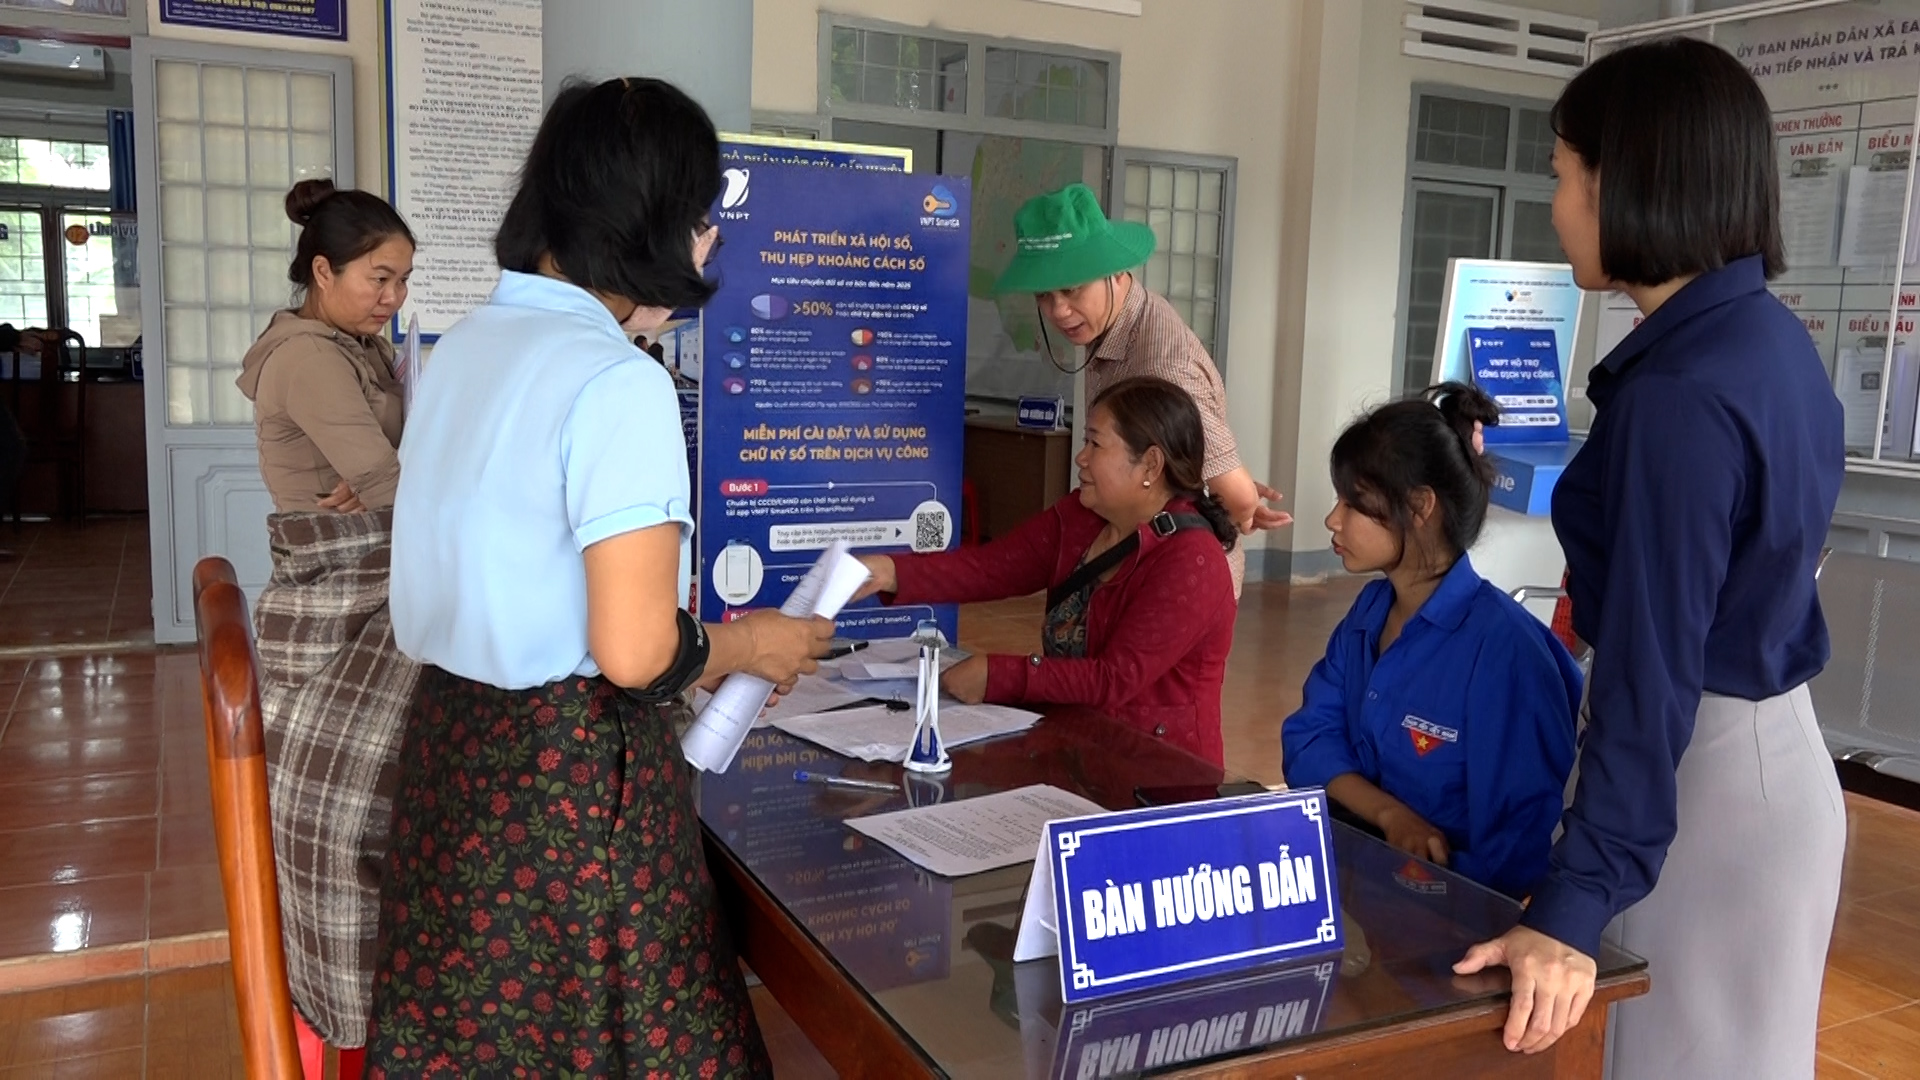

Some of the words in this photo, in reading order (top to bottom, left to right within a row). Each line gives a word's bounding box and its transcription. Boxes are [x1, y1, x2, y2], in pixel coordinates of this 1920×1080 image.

[1737, 43, 1754, 58] ỦY
[1758, 41, 1786, 56] BAN
[1790, 32, 1832, 50] NHÂN
[1836, 26, 1869, 44] DÂN
[1873, 20, 1896, 39] XÃ
[1776, 55, 1803, 74] TIẾP
[1806, 51, 1848, 71] NHẬN
[1854, 46, 1874, 63] VÀ
[1880, 40, 1908, 60] TRẢ
[1775, 119, 1800, 132] KHEN
[1803, 112, 1842, 130] THƯỞNG
[1790, 141, 1814, 156] VĂN
[1818, 137, 1843, 154] BẢN
[1868, 129, 1900, 150] BIỂU
[719, 211, 750, 220] VNPT
[920, 217, 935, 226] VNPT
[774, 229, 809, 244] PHÁT
[811, 230, 847, 247] TRIỂN
[850, 233, 867, 248] XÃ
[869, 233, 891, 251] HỘI
[893, 234, 913, 251] SỐ,
[760, 251, 786, 264] THU
[789, 253, 814, 268] HẸP
[817, 252, 870, 269] KHOẢNG
[873, 255, 906, 270] CÁCH
[909, 255, 926, 271] SỐ
[793, 301, 834, 316] >50%
[1848, 314, 1879, 333] BIỂU
[1510, 357, 1522, 368] HỖ
[1523, 359, 1540, 368] TRỢ
[1500, 370, 1520, 379] DỊCH
[1520, 371, 1531, 380] VỤ
[1532, 369, 1555, 378] CÔNG
[744, 423, 776, 440] MIỄN
[779, 425, 801, 440] PHÍ
[803, 424, 825, 440] CÀI
[827, 425, 852, 442] ĐẶT
[854, 424, 871, 439] VÀ
[873, 423, 890, 439] SỬ
[892, 427, 926, 441] DỤNG
[739, 446, 768, 462] CHỮ
[770, 445, 787, 461] KÝ
[789, 444, 807, 461] SỐ
[809, 445, 841, 461] TRÊN
[843, 447, 873, 462] DỊCH
[876, 447, 892, 462] VỤ
[895, 444, 929, 460] CÔNG
[729, 483, 752, 492] Bước
[754, 483, 759, 492] 1
[1081, 879, 1146, 940] BÀN
[1151, 863, 1254, 929] HƯỚNG
[1258, 843, 1317, 910] DẪN
